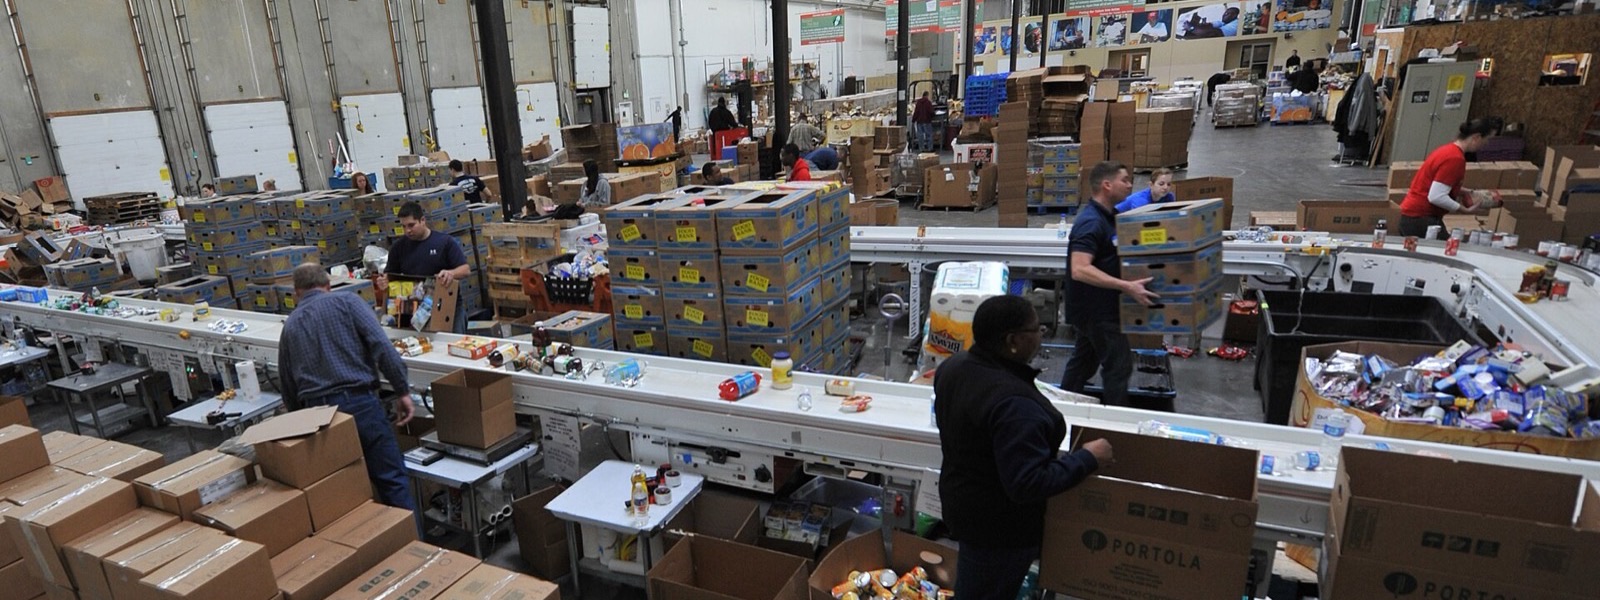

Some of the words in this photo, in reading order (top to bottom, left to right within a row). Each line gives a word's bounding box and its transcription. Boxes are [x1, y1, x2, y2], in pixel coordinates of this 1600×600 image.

[624, 226, 636, 234] FOOD
[735, 222, 752, 231] FOOD
[624, 230, 638, 238] BANK
[738, 228, 752, 236] BANK
[749, 279, 765, 288] BANK
[750, 274, 767, 284] FOOD
[1112, 538, 1201, 571] PORTOLA
